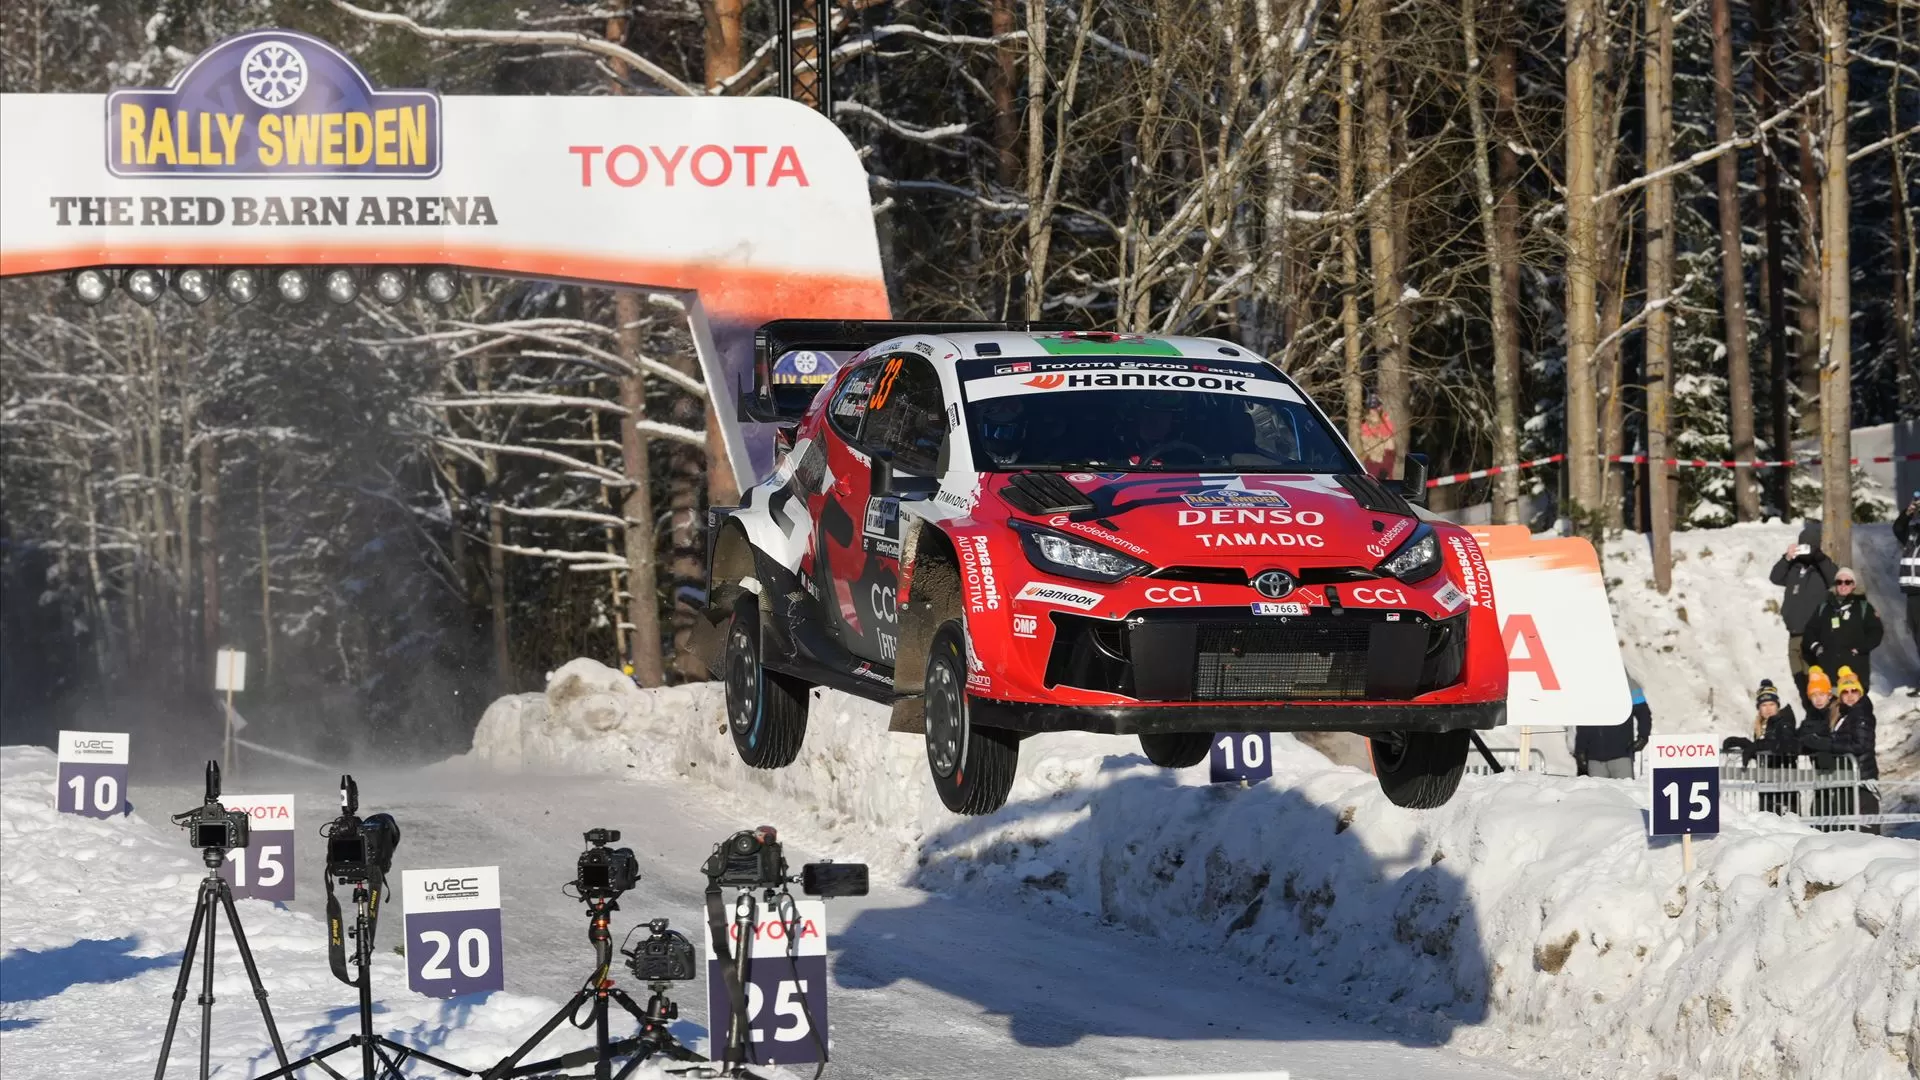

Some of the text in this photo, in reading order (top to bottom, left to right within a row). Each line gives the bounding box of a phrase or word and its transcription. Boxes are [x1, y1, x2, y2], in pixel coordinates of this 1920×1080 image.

[120, 104, 428, 167] RALLY SWEDEN
[569, 145, 809, 188] TOYOTA
[50, 196, 498, 227] THE RED BARN ARENA
[869, 358, 904, 410] 33
[996, 362, 1032, 375] GR
[1037, 361, 1256, 378] TOYOTA GAZOO Racing
[938, 490, 967, 509] TAMADIC
[1189, 495, 1225, 503] RALLY
[1178, 509, 1325, 527] DENSO
[1378, 518, 1410, 547] codebeamer
[1070, 522, 1145, 555] codebeamer
[1196, 533, 1325, 548] TAMADIC
[956, 536, 985, 613] AUTOMOTIVE
[972, 535, 1001, 610] Panasonic
[1448, 536, 1479, 606] Panasonic
[1460, 536, 1493, 610] AUTOMOTIVE
[871, 583, 898, 624] CCi
[1144, 586, 1203, 603] CCi
[1264, 604, 1299, 614] A-7663
[1353, 587, 1407, 605] CCi
[1014, 618, 1037, 635] OMP
[74, 739, 113, 750] WRC
[1217, 734, 1265, 770] 10
[1656, 744, 1715, 758] TOYOTA
[67, 775, 118, 812] 10
[1662, 781, 1712, 821] 15
[225, 845, 285, 887] 15
[424, 877, 479, 893] WRC
[726, 919, 819, 942] OYOA
[419, 928, 490, 981] 20
[727, 980, 811, 1042] 25
